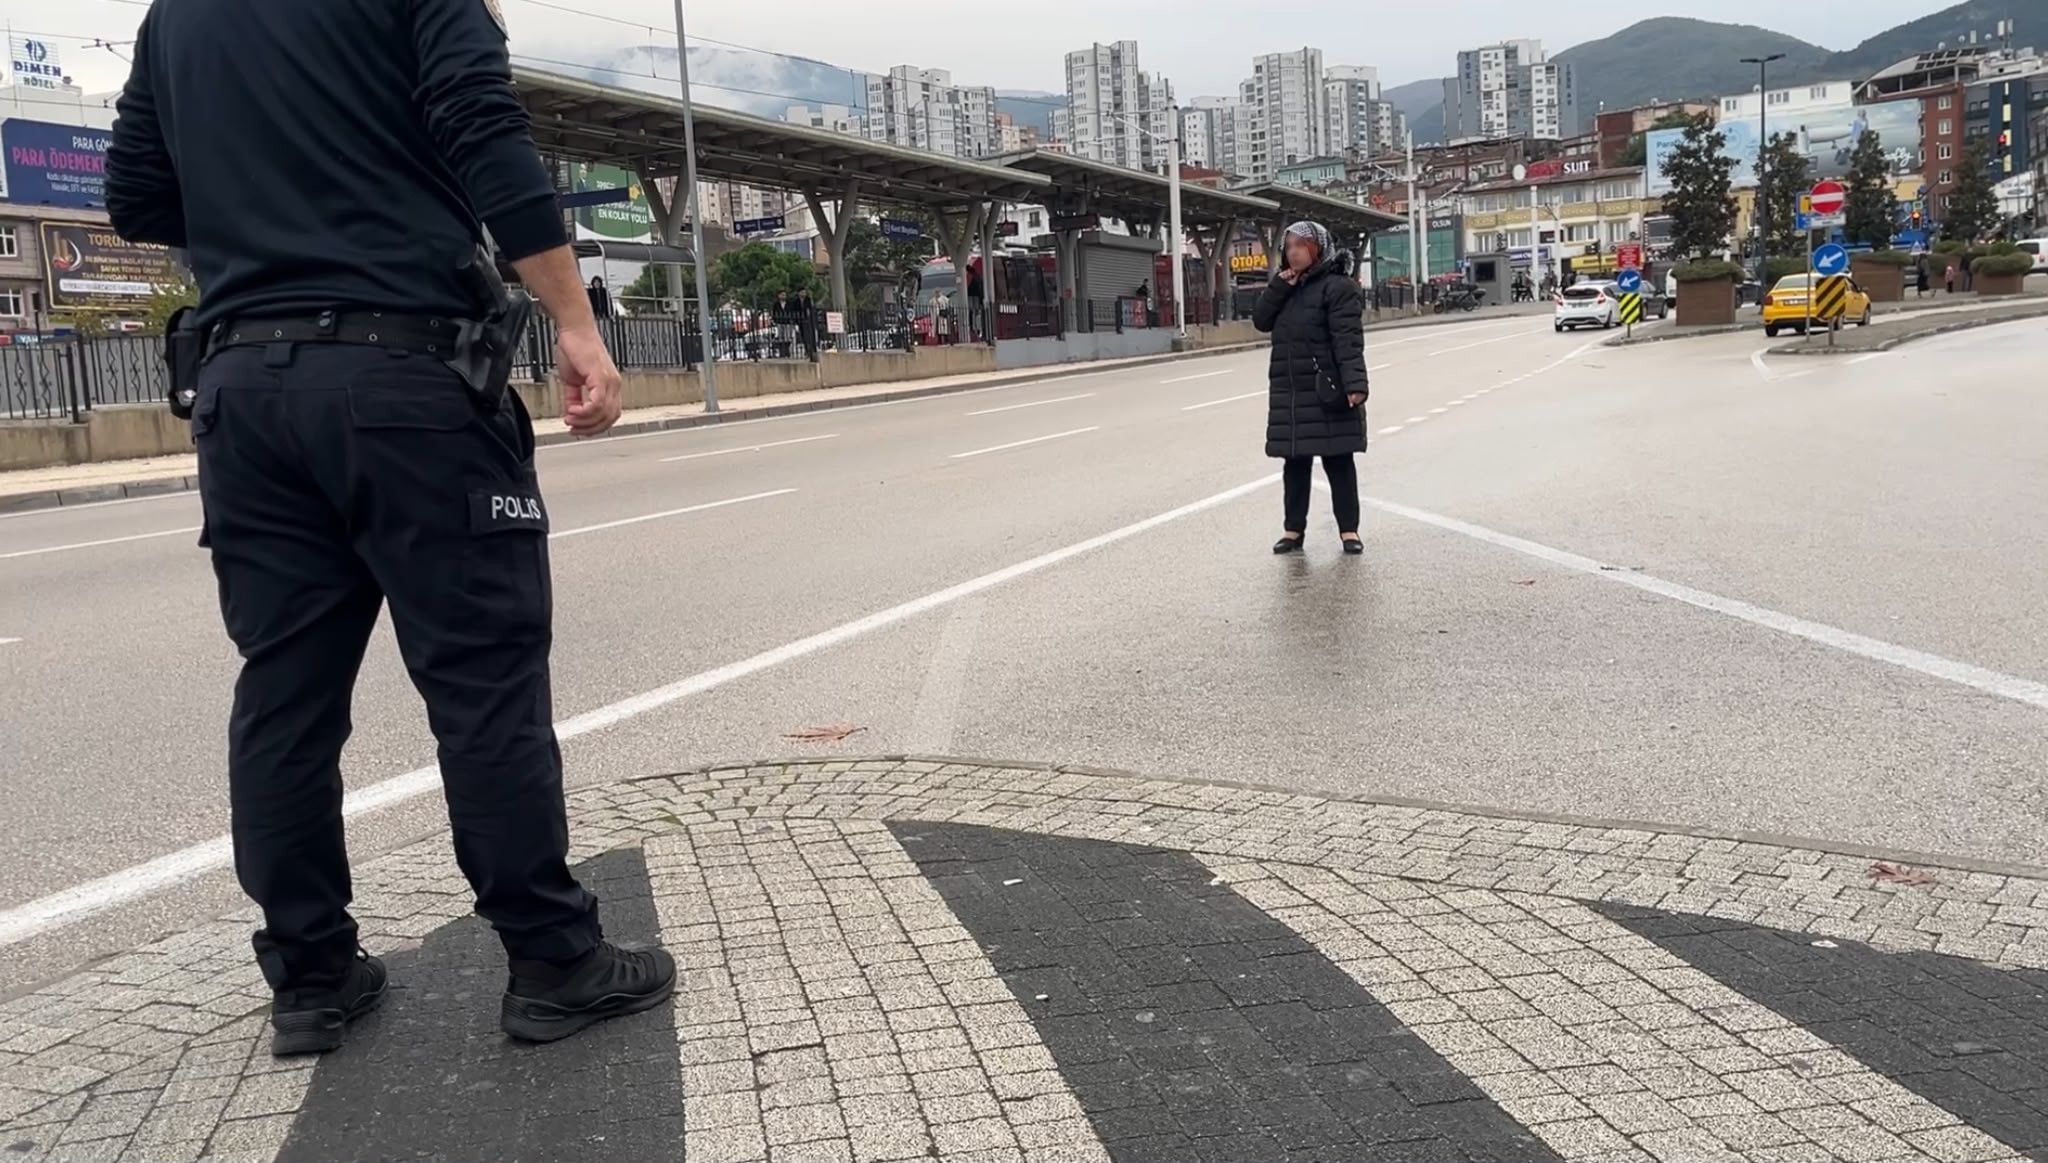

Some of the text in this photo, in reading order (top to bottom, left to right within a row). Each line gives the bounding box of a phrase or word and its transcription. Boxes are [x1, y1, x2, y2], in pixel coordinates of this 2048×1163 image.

[72, 136, 94, 151] PARA
[12, 146, 47, 168] PARA
[1564, 160, 1590, 174] SUIT
[491, 496, 541, 520] POLİS
